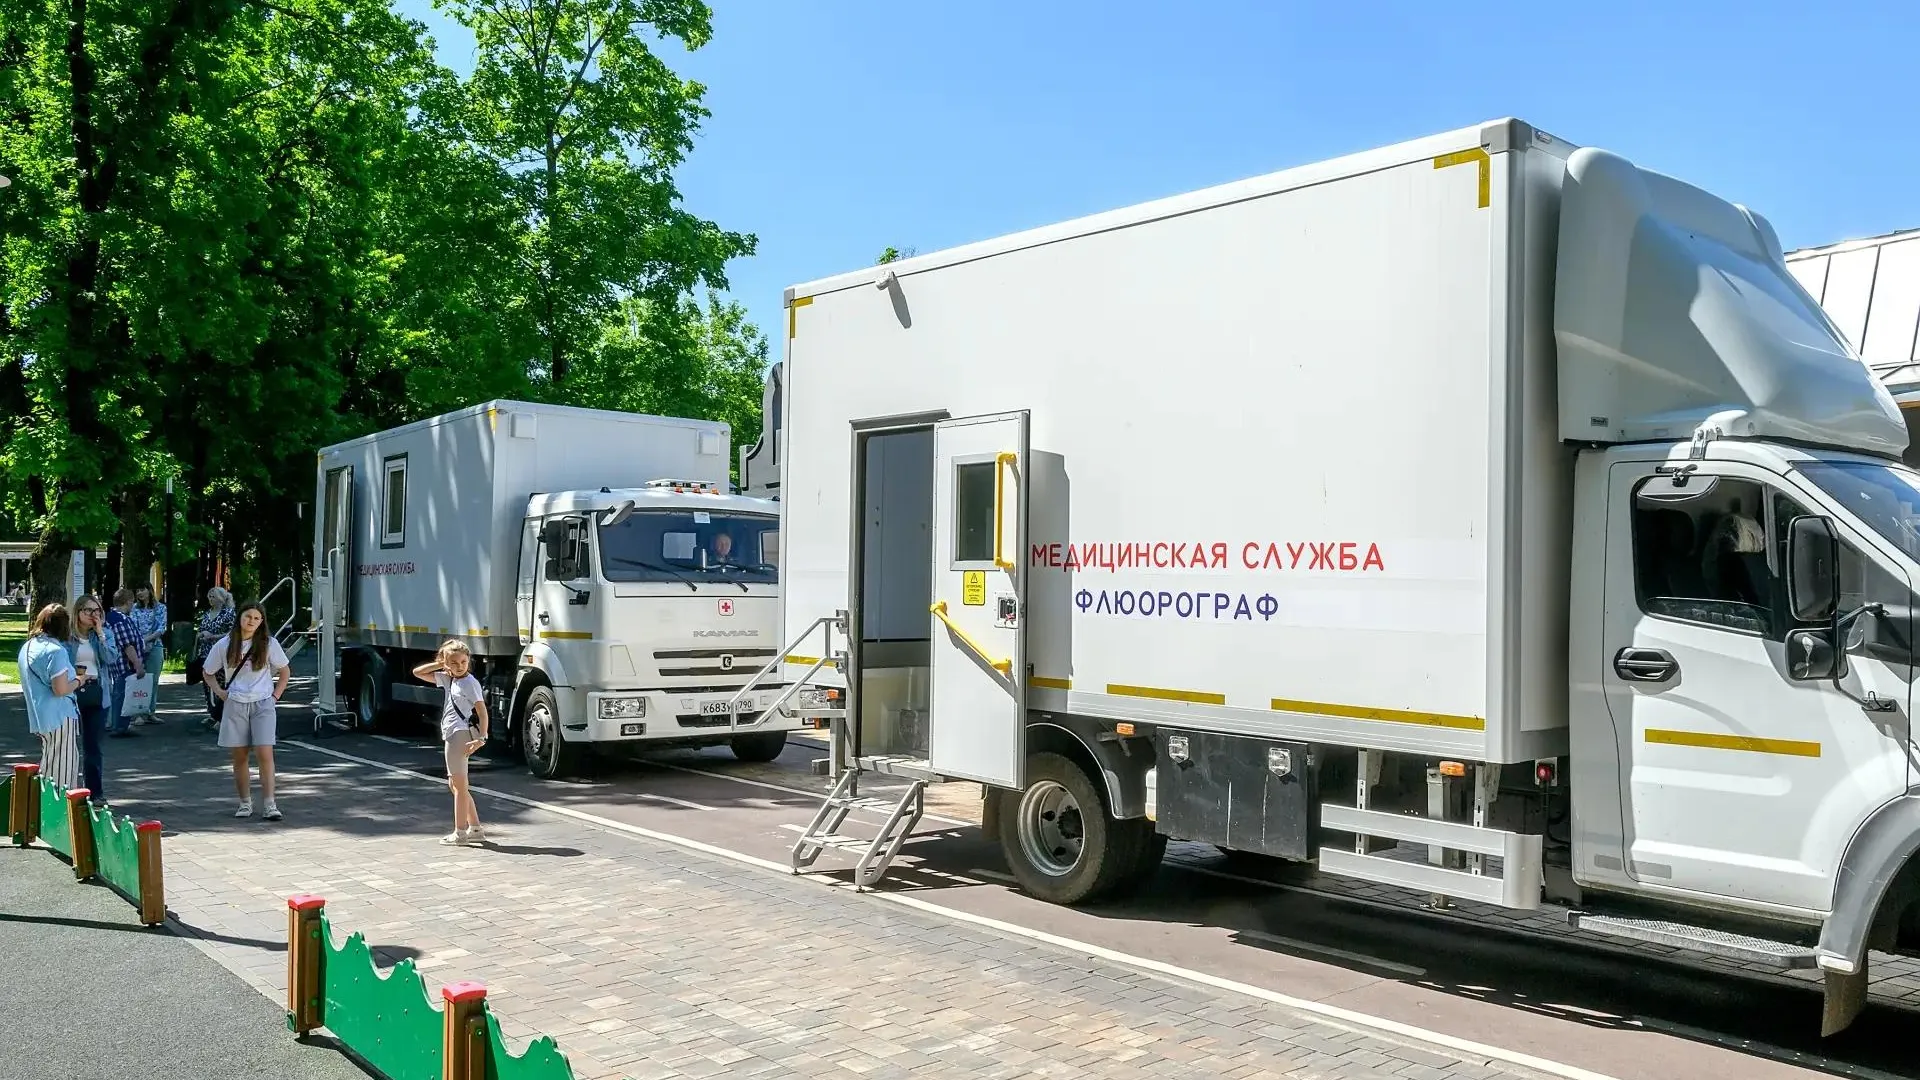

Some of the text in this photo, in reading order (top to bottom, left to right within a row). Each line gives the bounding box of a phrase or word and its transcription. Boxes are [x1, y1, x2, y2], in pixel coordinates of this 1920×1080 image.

[1031, 542, 1384, 573] МЕДИЦИНСКАЯ СЛУЖБА
[1075, 588, 1279, 621] ФЛЮОРОГРАФ
